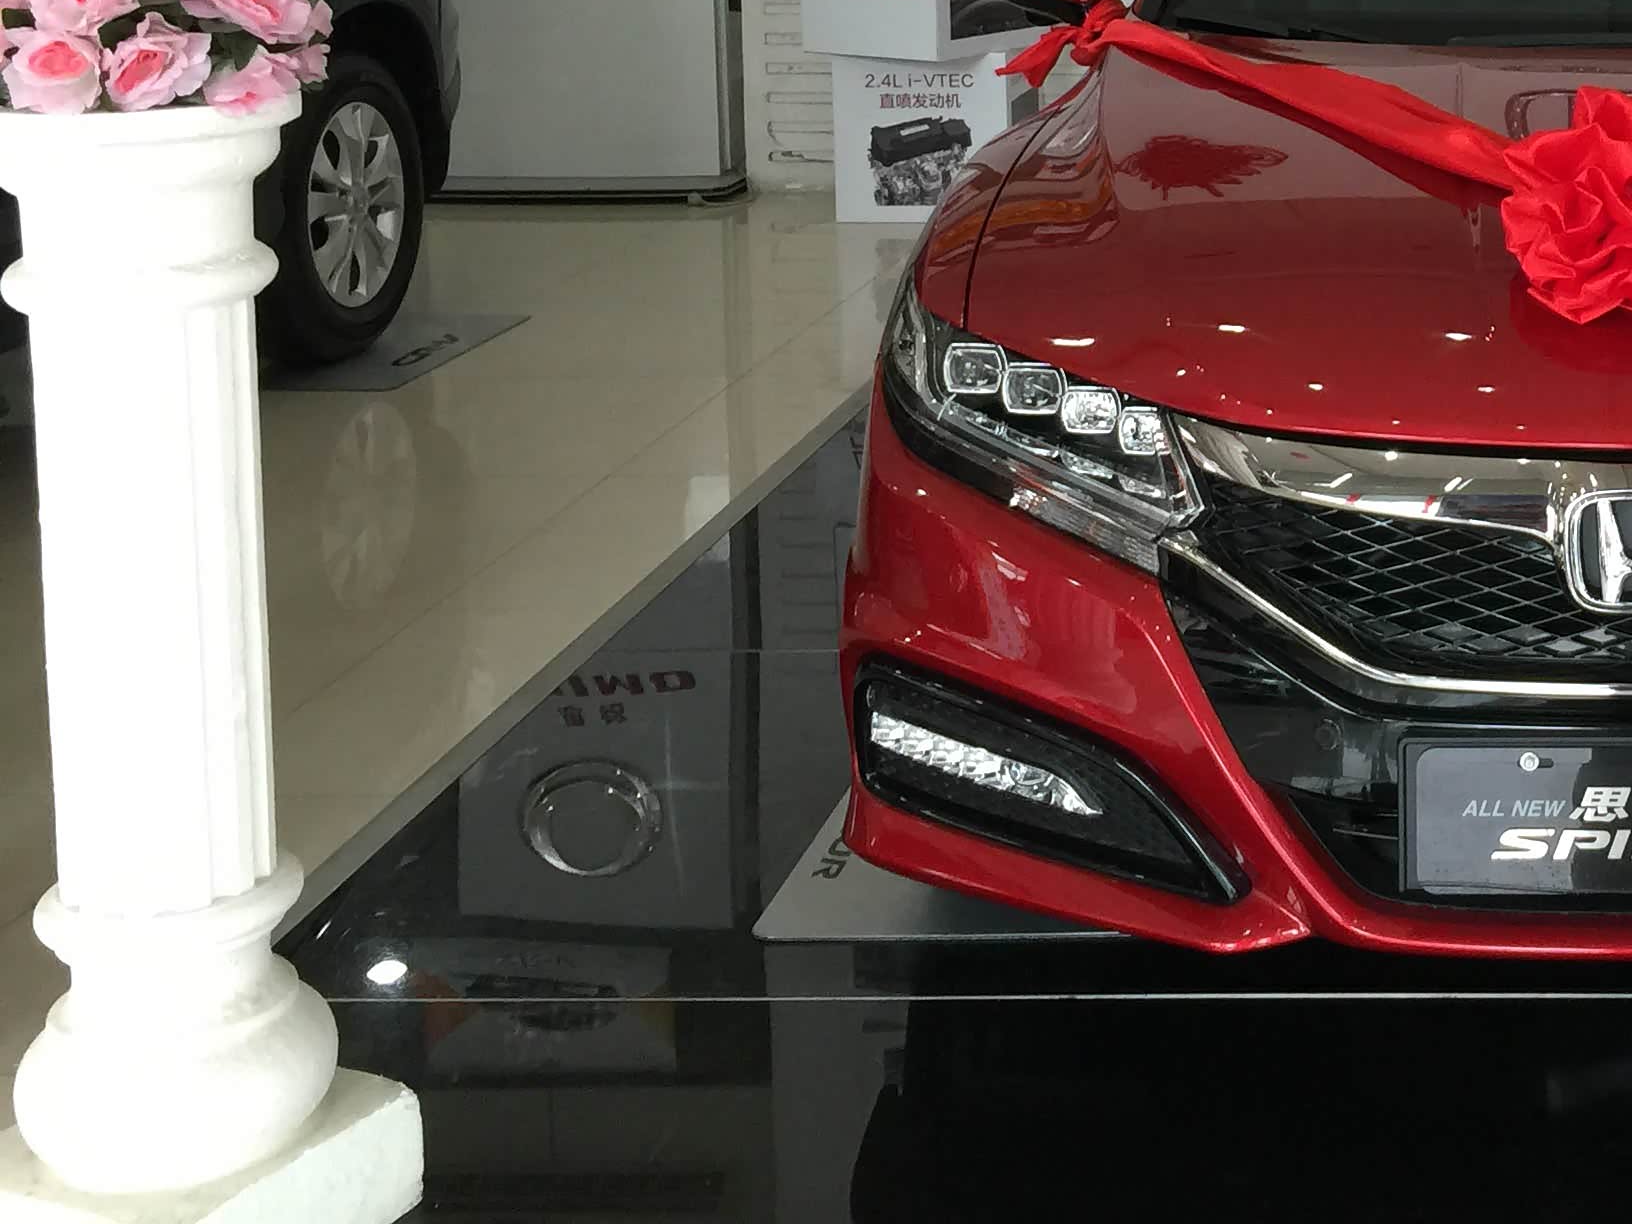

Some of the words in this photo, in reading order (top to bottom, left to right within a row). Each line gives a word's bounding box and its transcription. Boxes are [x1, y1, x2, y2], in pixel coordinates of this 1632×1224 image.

[865, 74, 900, 88] 2.4L
[907, 73, 974, 89] i-VTEC
[879, 93, 961, 109] 直喷发动机
[1462, 799, 1506, 818] ALL
[1511, 798, 1567, 818] NEW
